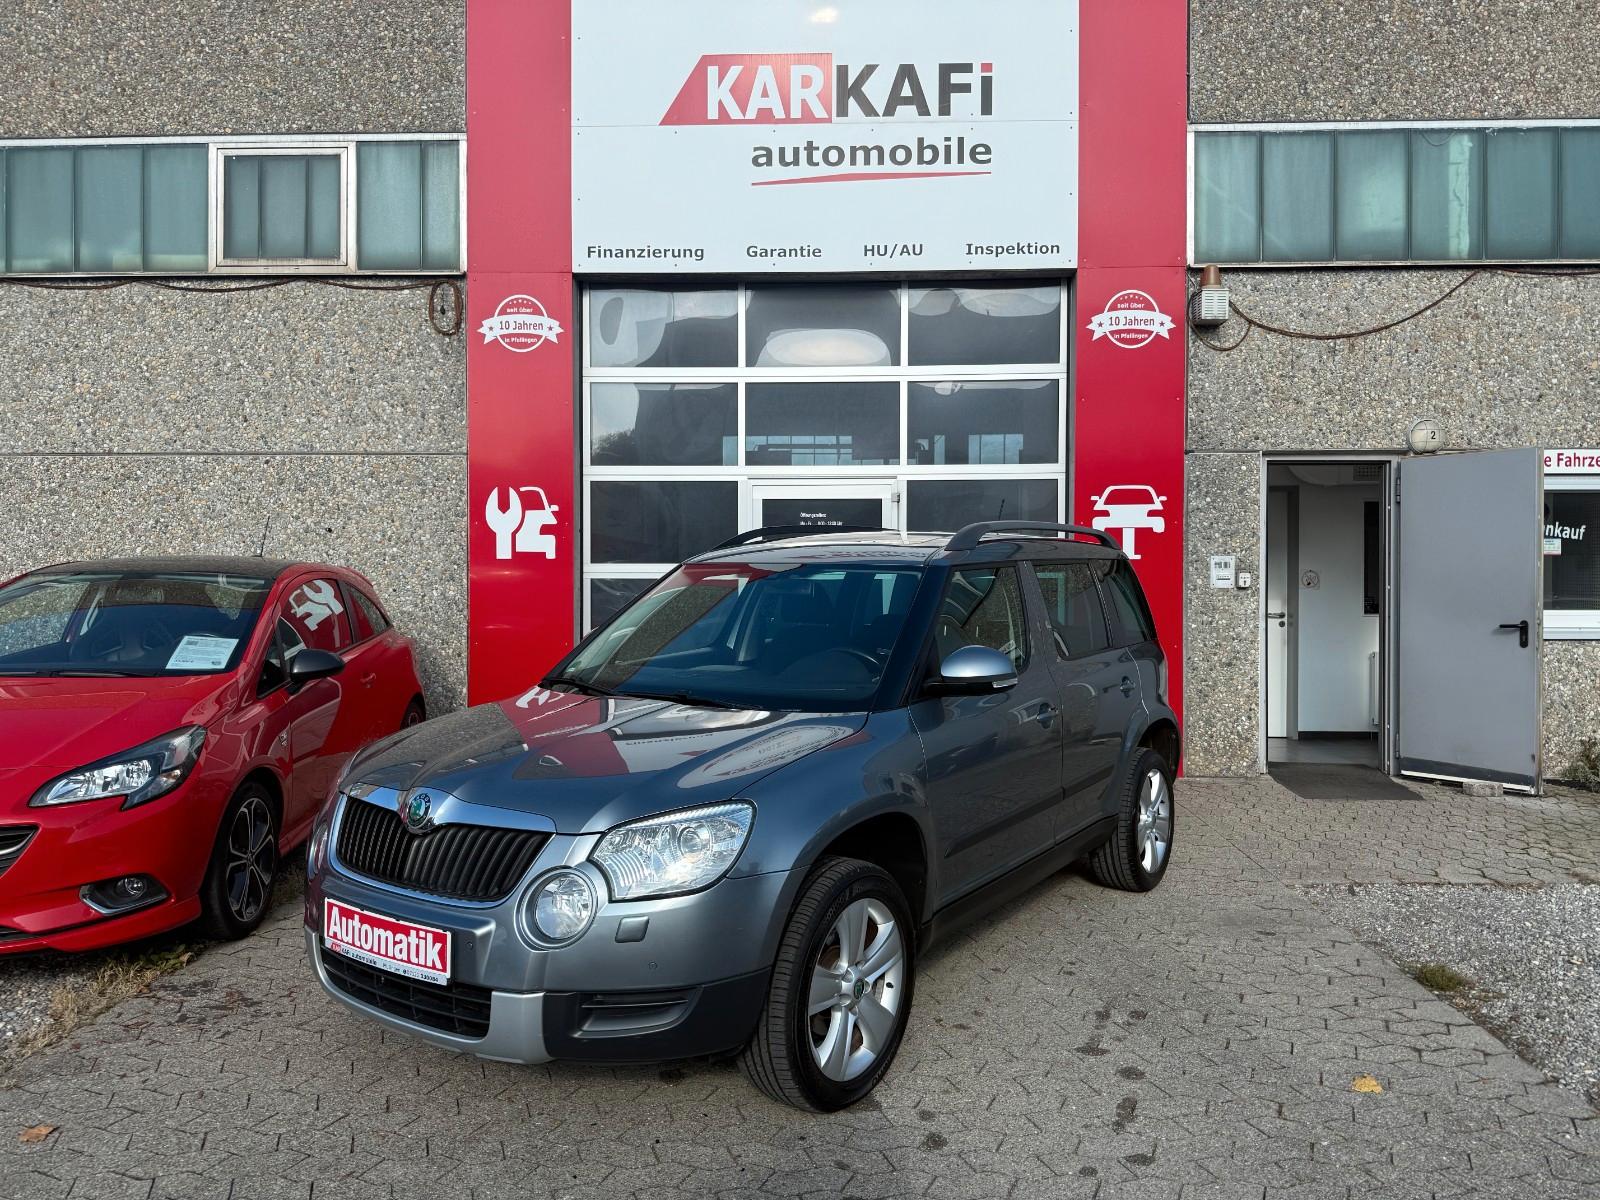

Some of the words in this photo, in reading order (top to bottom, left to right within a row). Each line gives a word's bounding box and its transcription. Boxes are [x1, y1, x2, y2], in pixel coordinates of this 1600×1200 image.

[751, 137, 993, 168] automobile
[586, 245, 705, 262] Finanzierung
[745, 244, 823, 258] Garantie
[863, 243, 924, 258] HU/AU
[965, 241, 1061, 257] Inspektion
[499, 320, 510, 330] 10
[512, 320, 544, 331] Jahren
[1109, 316, 1120, 326] 10
[1123, 316, 1155, 326] Jahren
[1430, 430, 1436, 440] 2
[1544, 521, 1587, 540] nkauf
[328, 905, 443, 970] Automatik
